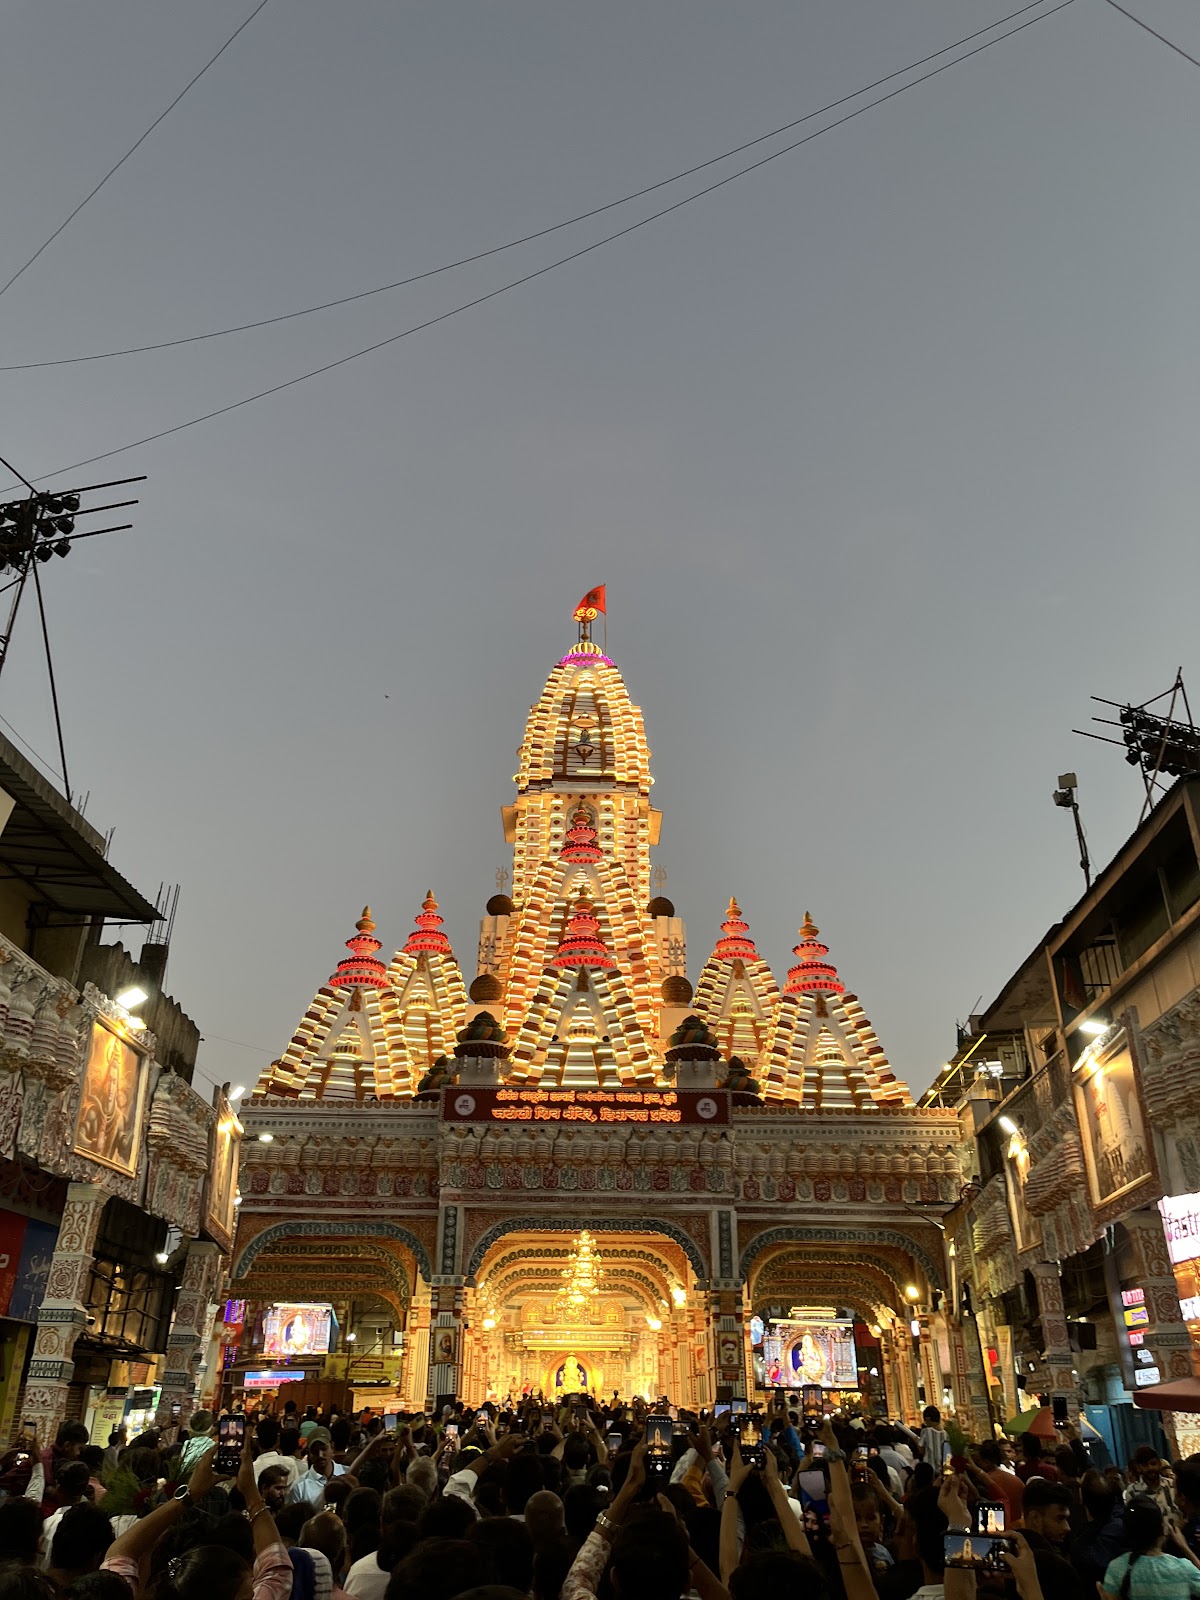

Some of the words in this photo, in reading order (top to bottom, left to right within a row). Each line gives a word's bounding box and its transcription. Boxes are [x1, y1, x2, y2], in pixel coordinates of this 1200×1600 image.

[534, 1105, 561, 1120] शिव
[562, 1105, 598, 1123] मंदिर,
[600, 1106, 649, 1122] हिमाचल
[650, 1106, 682, 1122] प्रदेश
